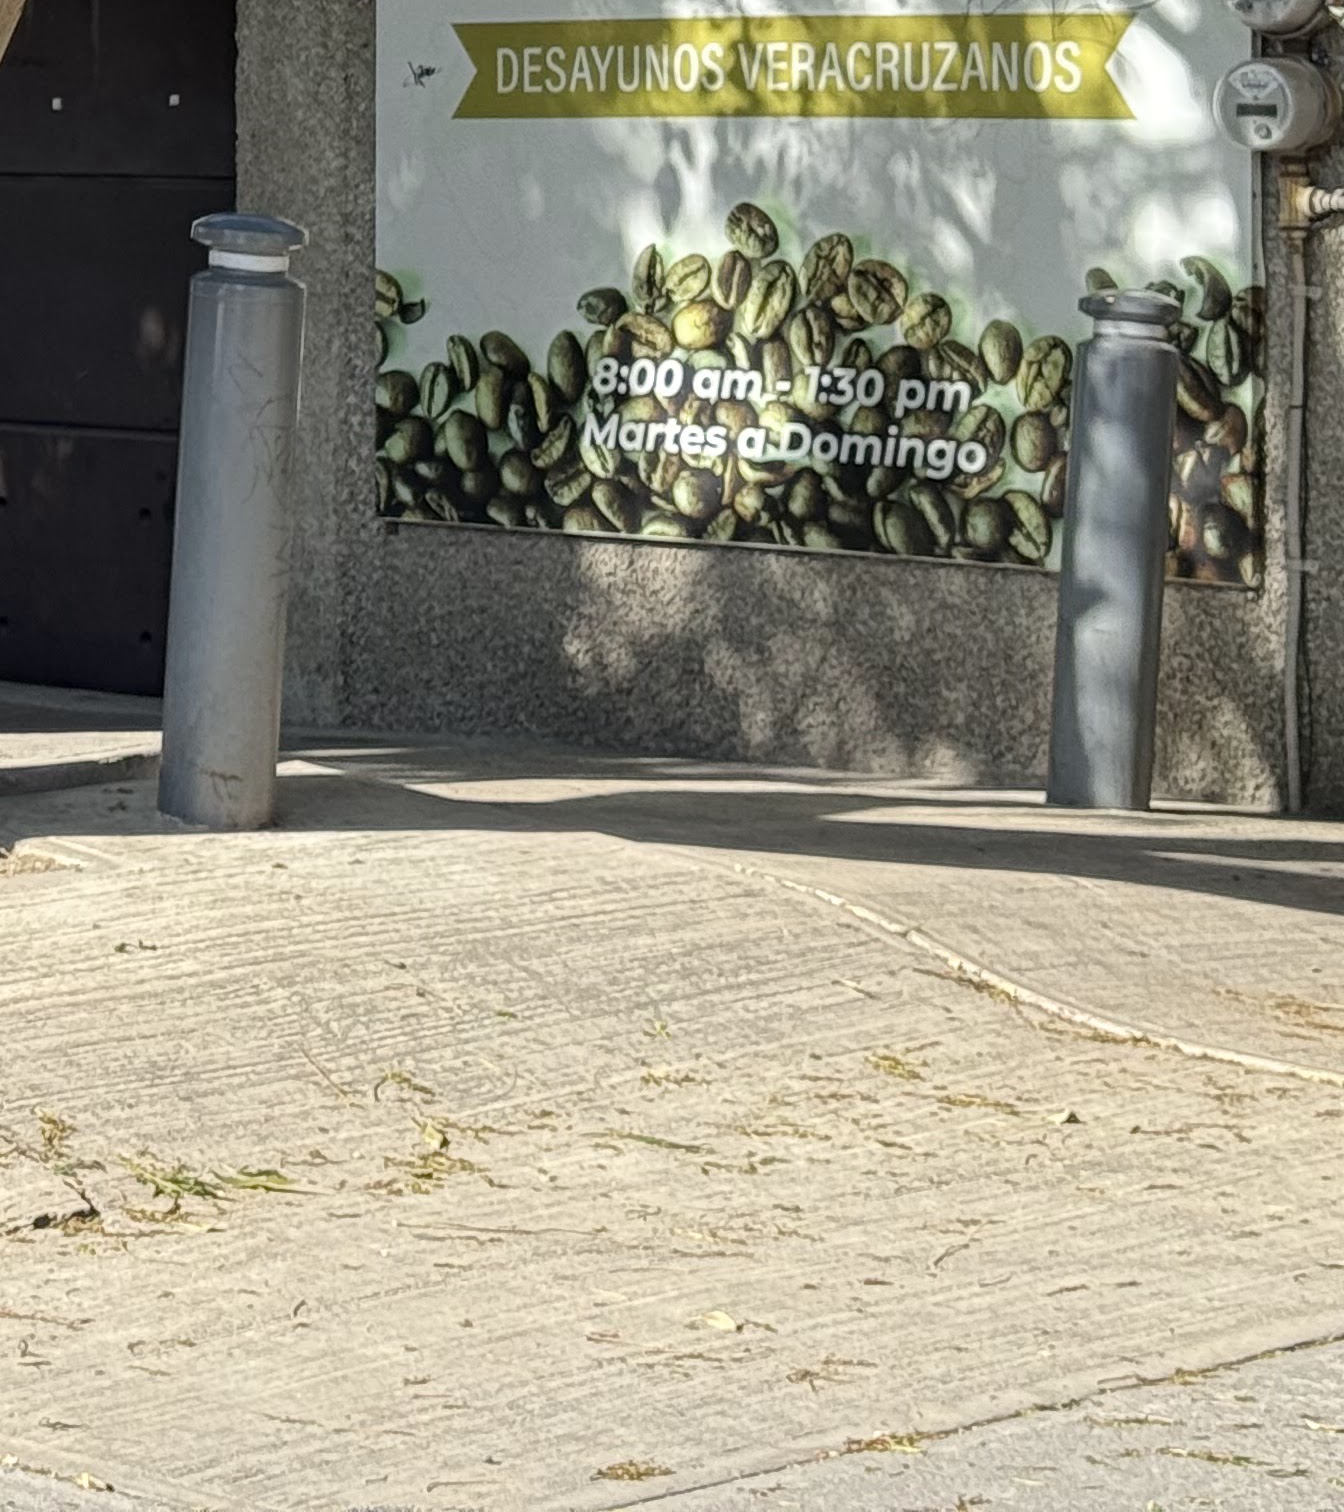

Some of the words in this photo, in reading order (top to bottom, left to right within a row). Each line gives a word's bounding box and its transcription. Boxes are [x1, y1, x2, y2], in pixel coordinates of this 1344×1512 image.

[495, 44, 725, 95] DESAYUNOS
[739, 40, 1084, 94] VERACRUZANOS
[593, 358, 683, 397] 8:00
[804, 365, 885, 408] 1:30
[894, 376, 972, 419] pm
[584, 410, 728, 457] Martes
[777, 421, 988, 480] Domingo
